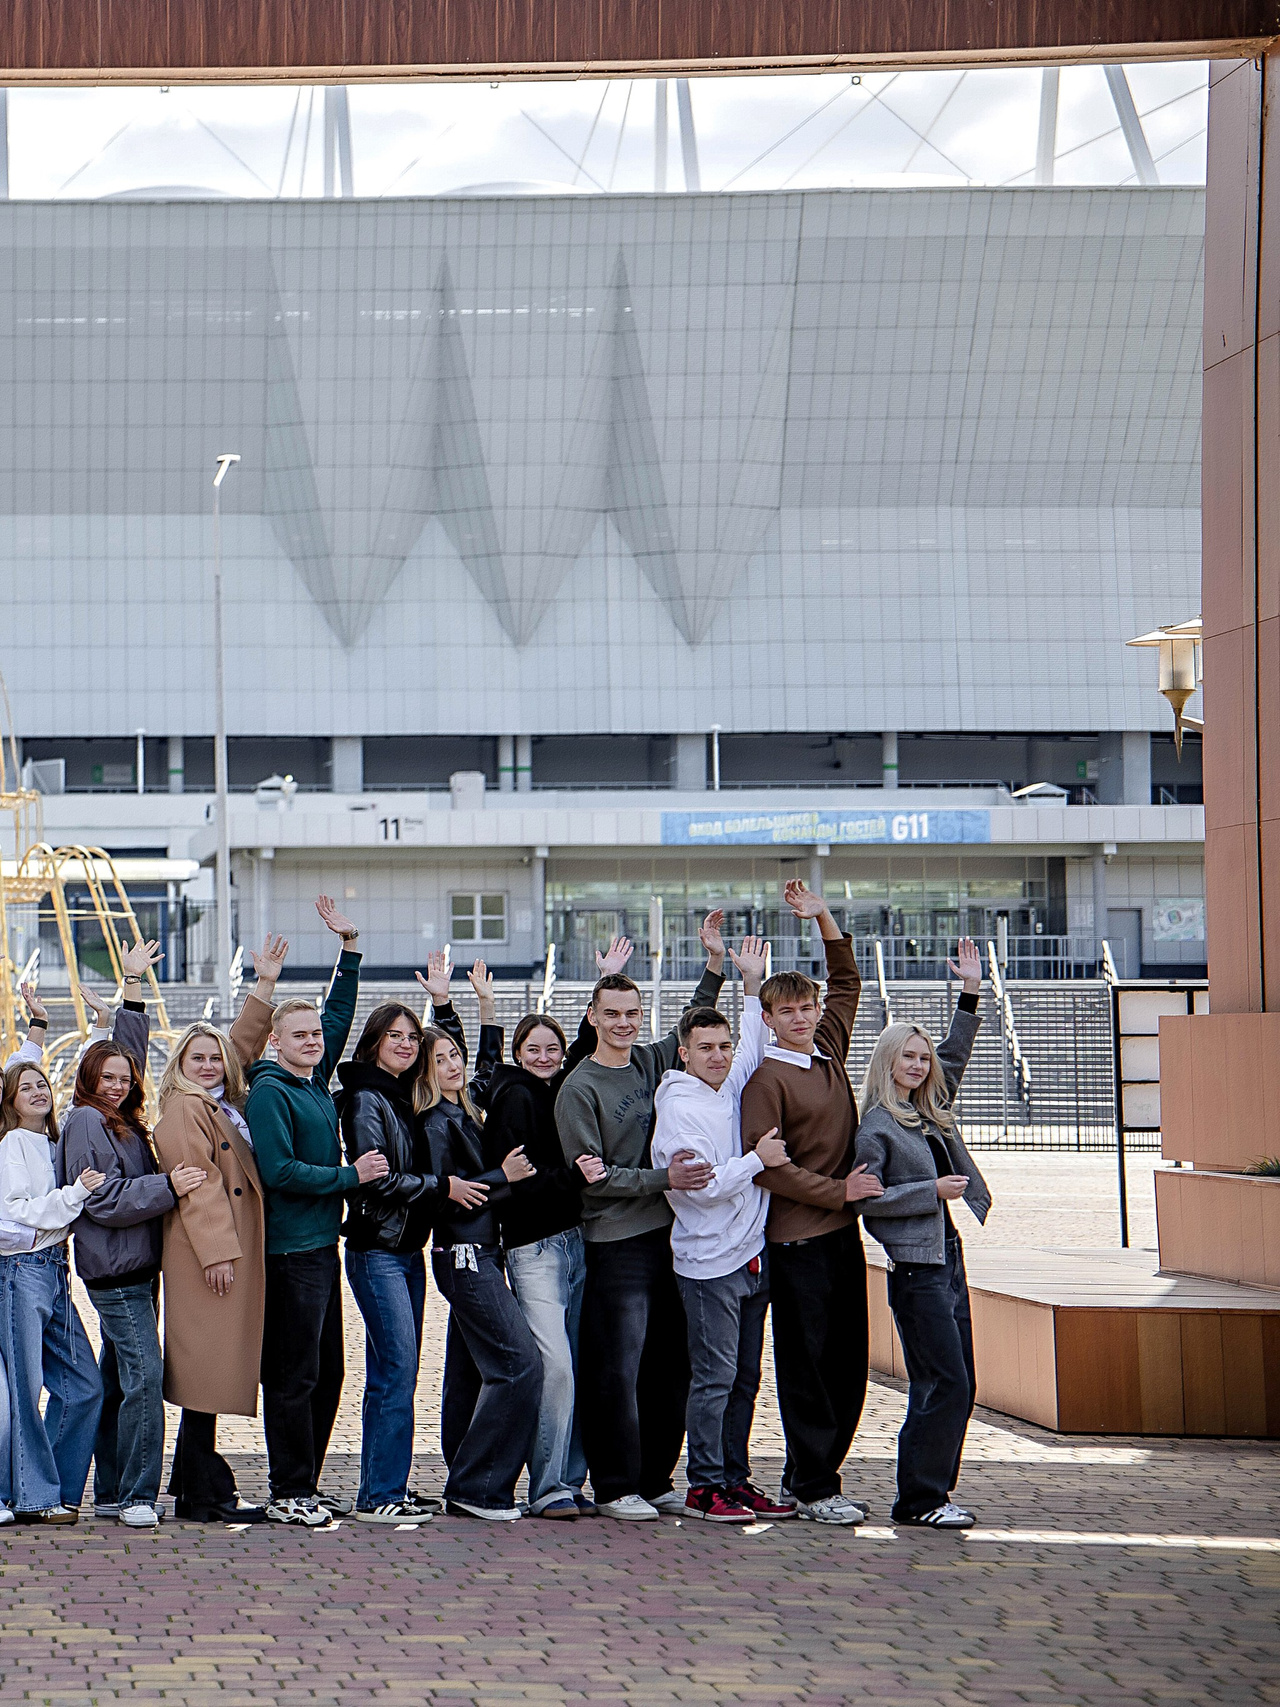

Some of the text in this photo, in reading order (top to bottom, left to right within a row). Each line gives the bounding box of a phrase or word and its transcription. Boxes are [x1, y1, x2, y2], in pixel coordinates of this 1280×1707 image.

[379, 818, 400, 841] 11
[891, 812, 928, 841] G11
[613, 1094, 635, 1124] JEANS
